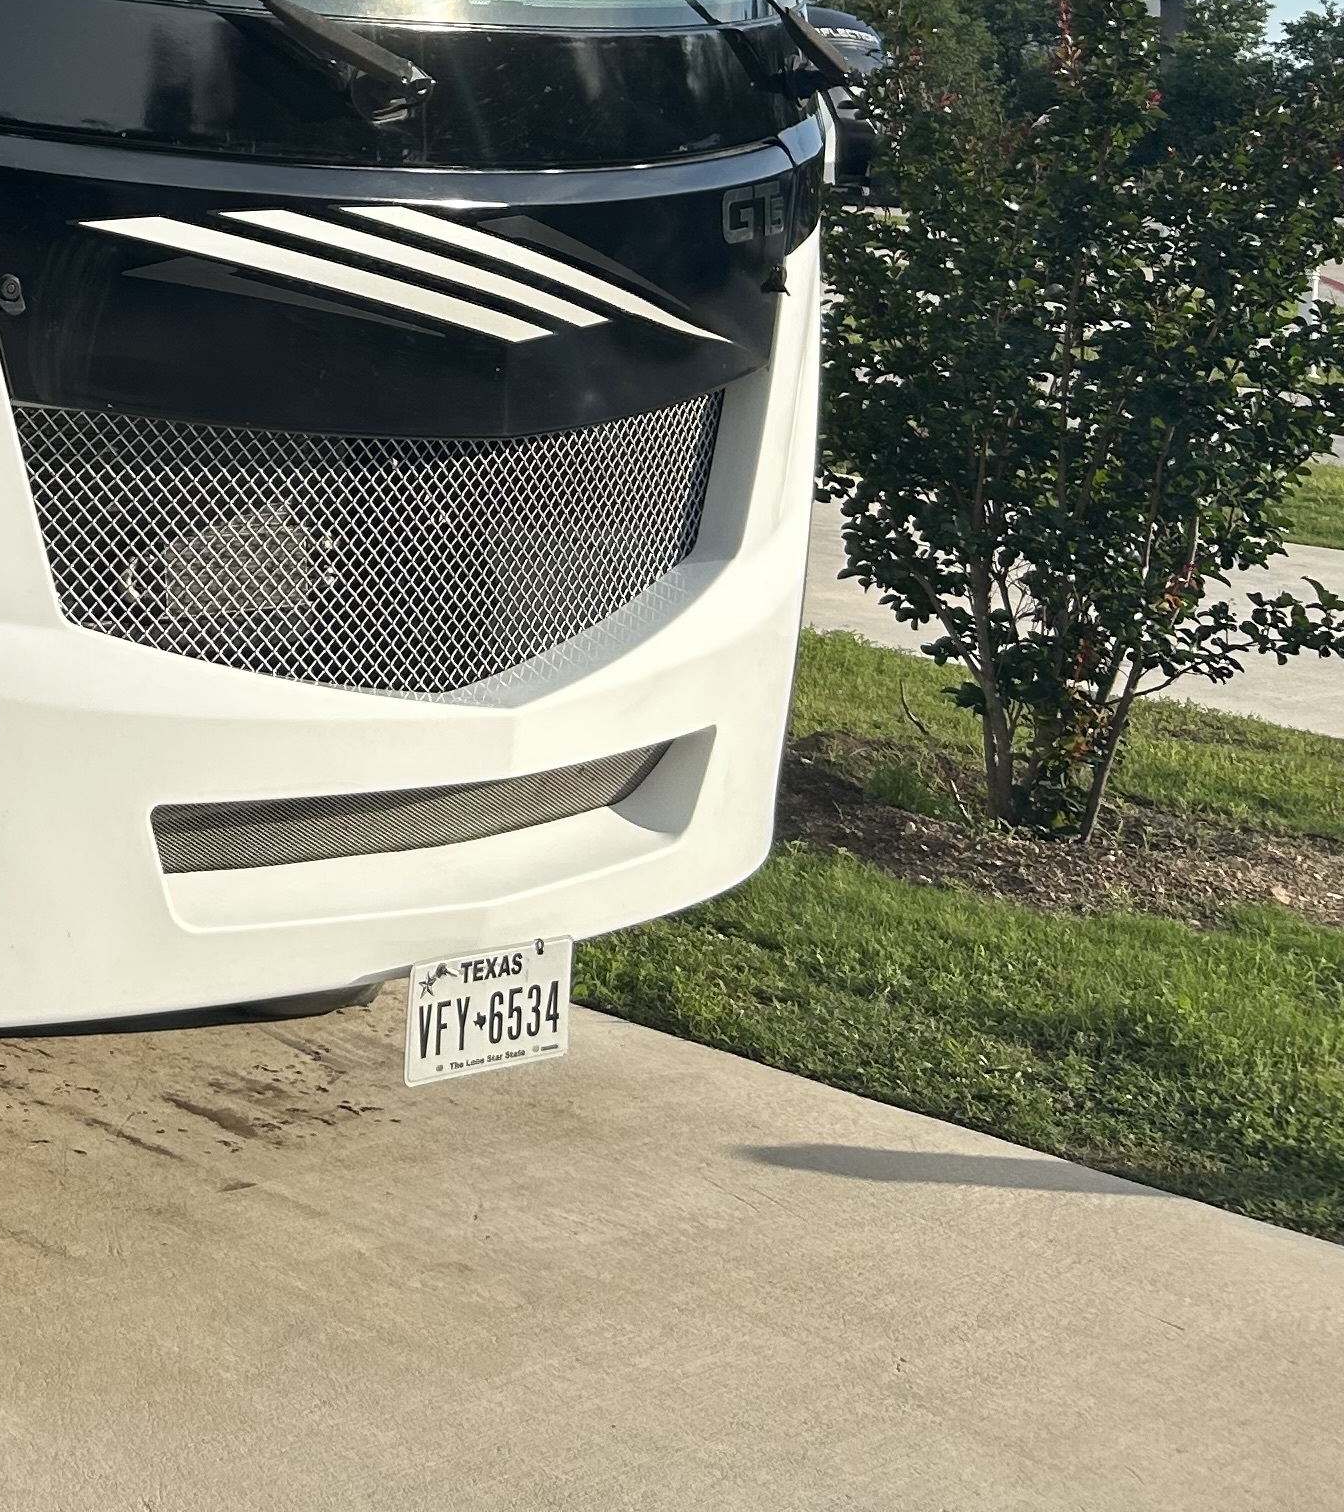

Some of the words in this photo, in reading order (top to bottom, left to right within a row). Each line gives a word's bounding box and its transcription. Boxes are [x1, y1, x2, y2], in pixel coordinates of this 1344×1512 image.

[460, 952, 523, 984] TEXAS
[449, 1061, 464, 1070] The
[487, 1053, 503, 1063] Star
